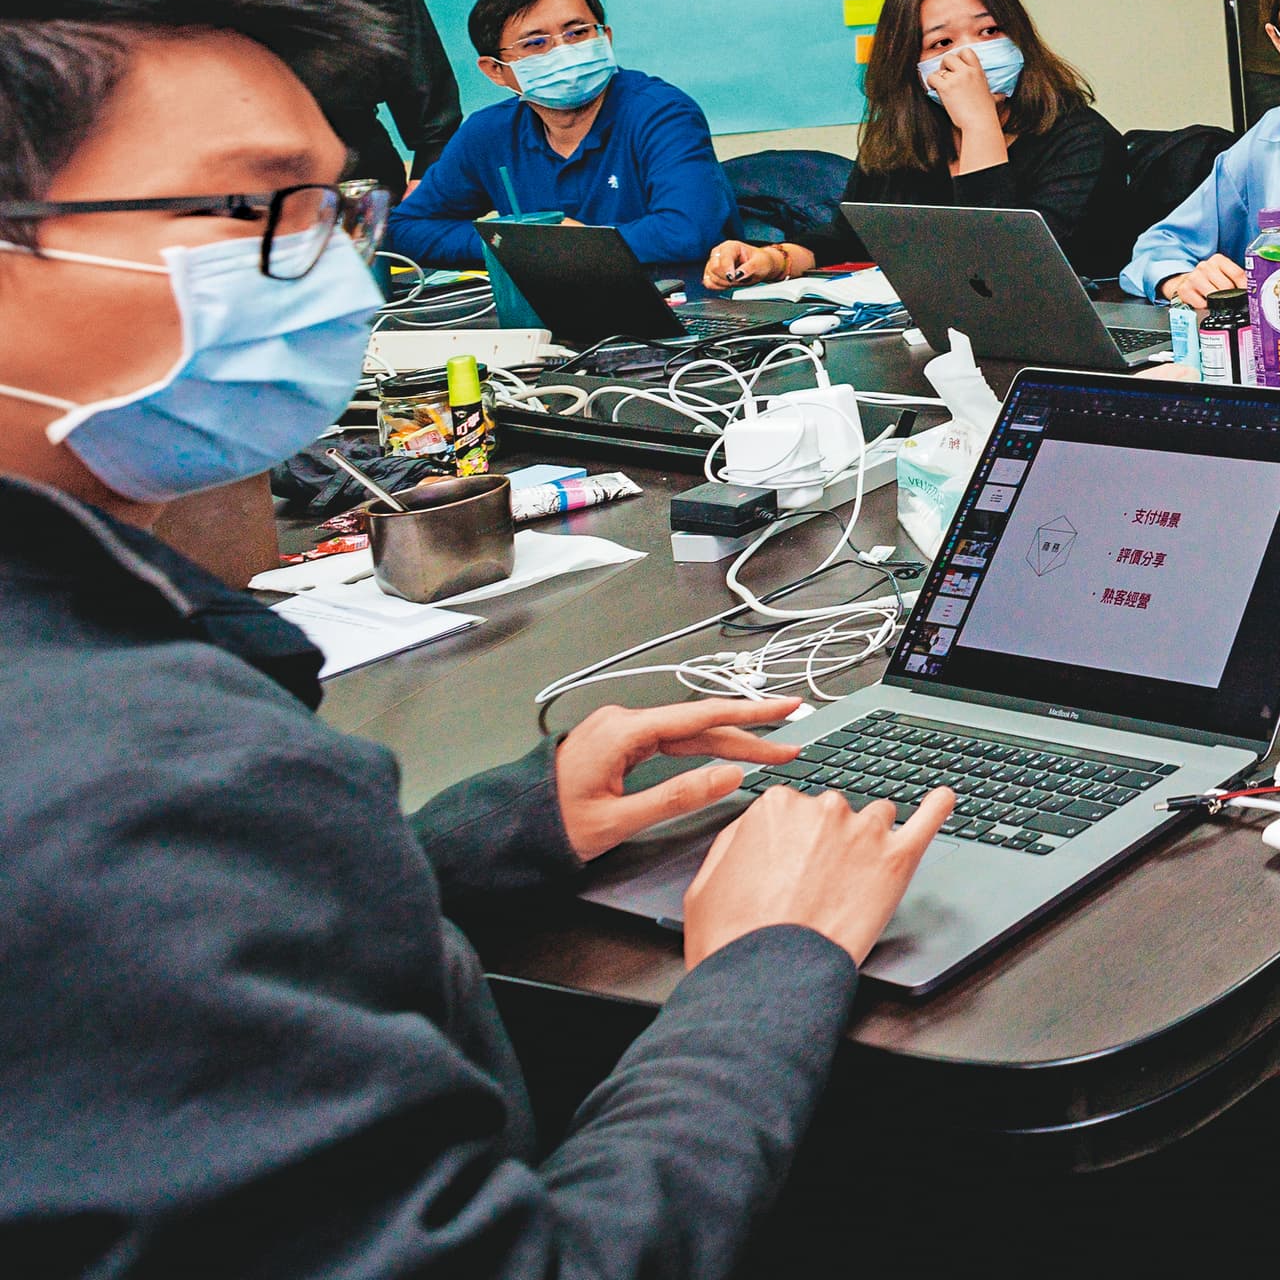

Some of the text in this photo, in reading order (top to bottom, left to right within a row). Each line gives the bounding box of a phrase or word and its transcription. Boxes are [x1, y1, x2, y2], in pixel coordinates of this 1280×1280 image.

[1131, 508, 1181, 528] 支付場景
[1116, 547, 1167, 568] 評價分享
[1099, 588, 1152, 610] 熟客經營
